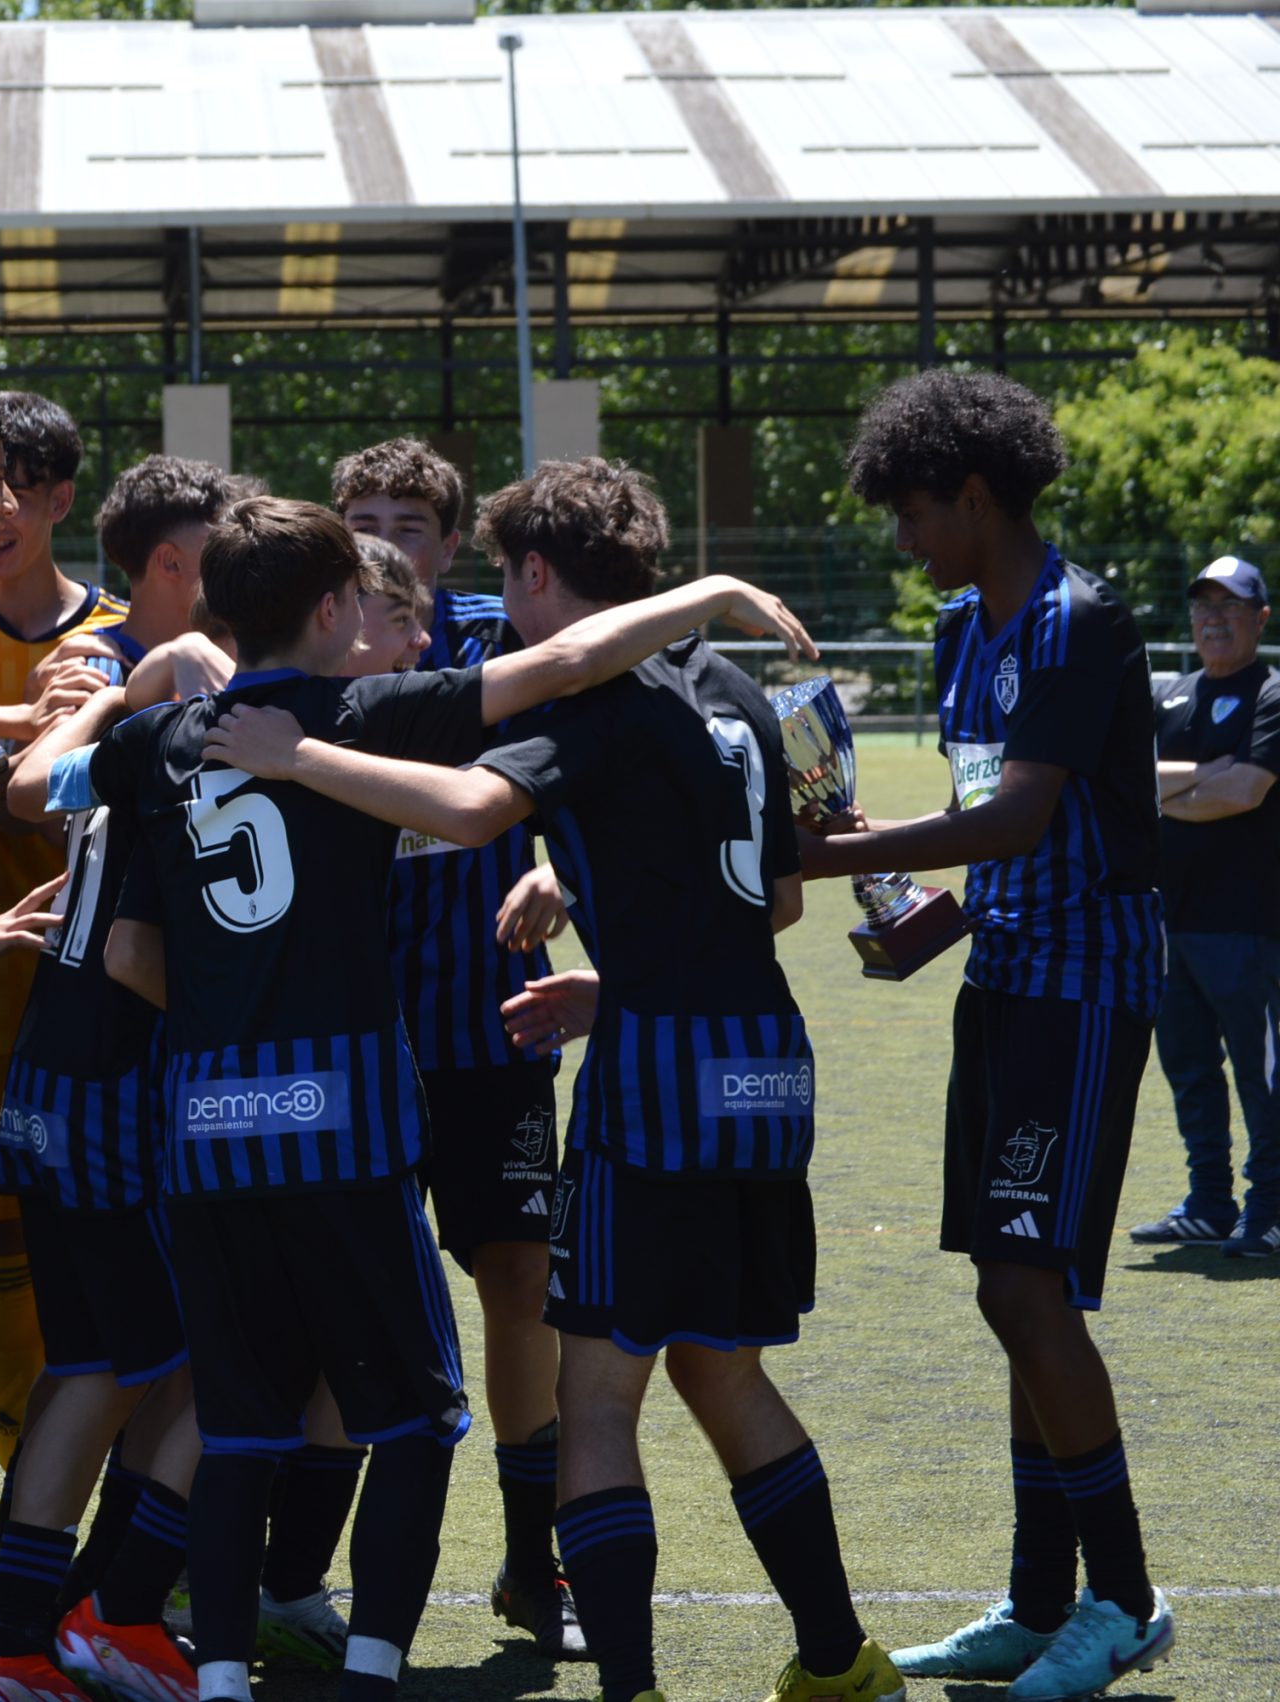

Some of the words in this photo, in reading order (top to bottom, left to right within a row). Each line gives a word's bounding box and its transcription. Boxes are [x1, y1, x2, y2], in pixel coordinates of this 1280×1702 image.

[184, 768, 295, 934] 5
[187, 1120, 254, 1132] equipamientos
[502, 1171, 552, 1181] PONFERRADA
